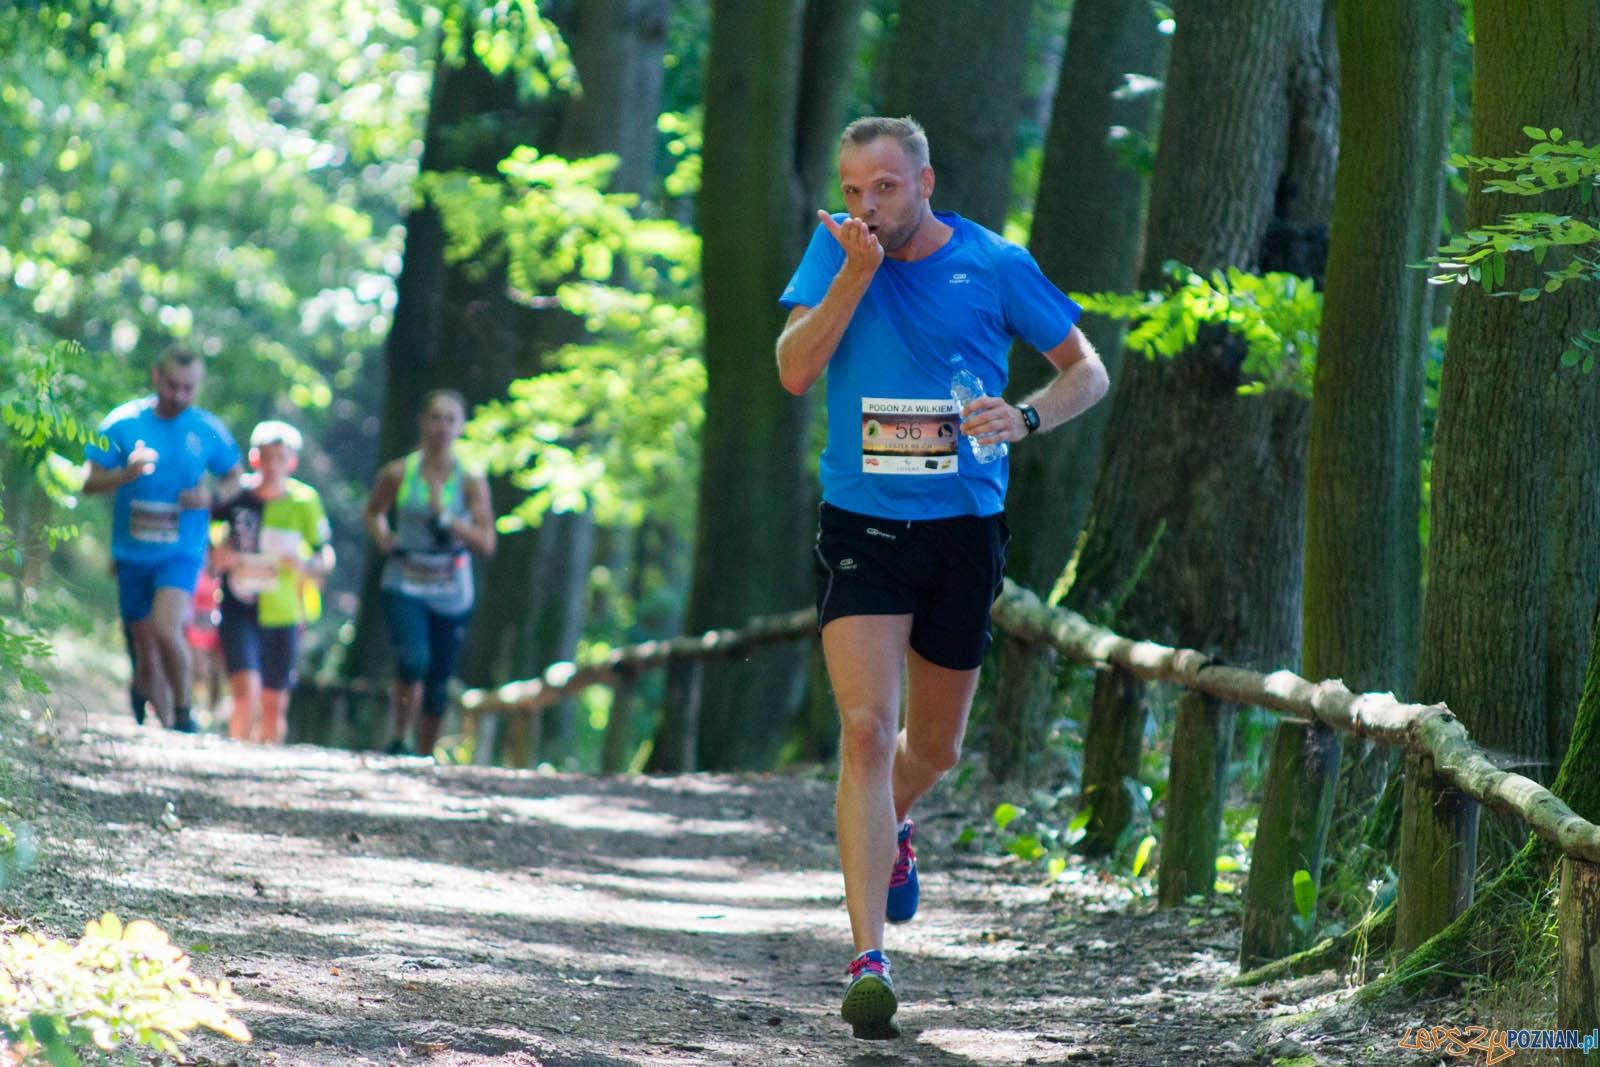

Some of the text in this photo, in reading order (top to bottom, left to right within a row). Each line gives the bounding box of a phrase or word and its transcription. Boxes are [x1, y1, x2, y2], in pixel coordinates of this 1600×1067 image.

[868, 403, 953, 413] POGON ZA WILKIEM
[895, 420, 922, 440] 56
